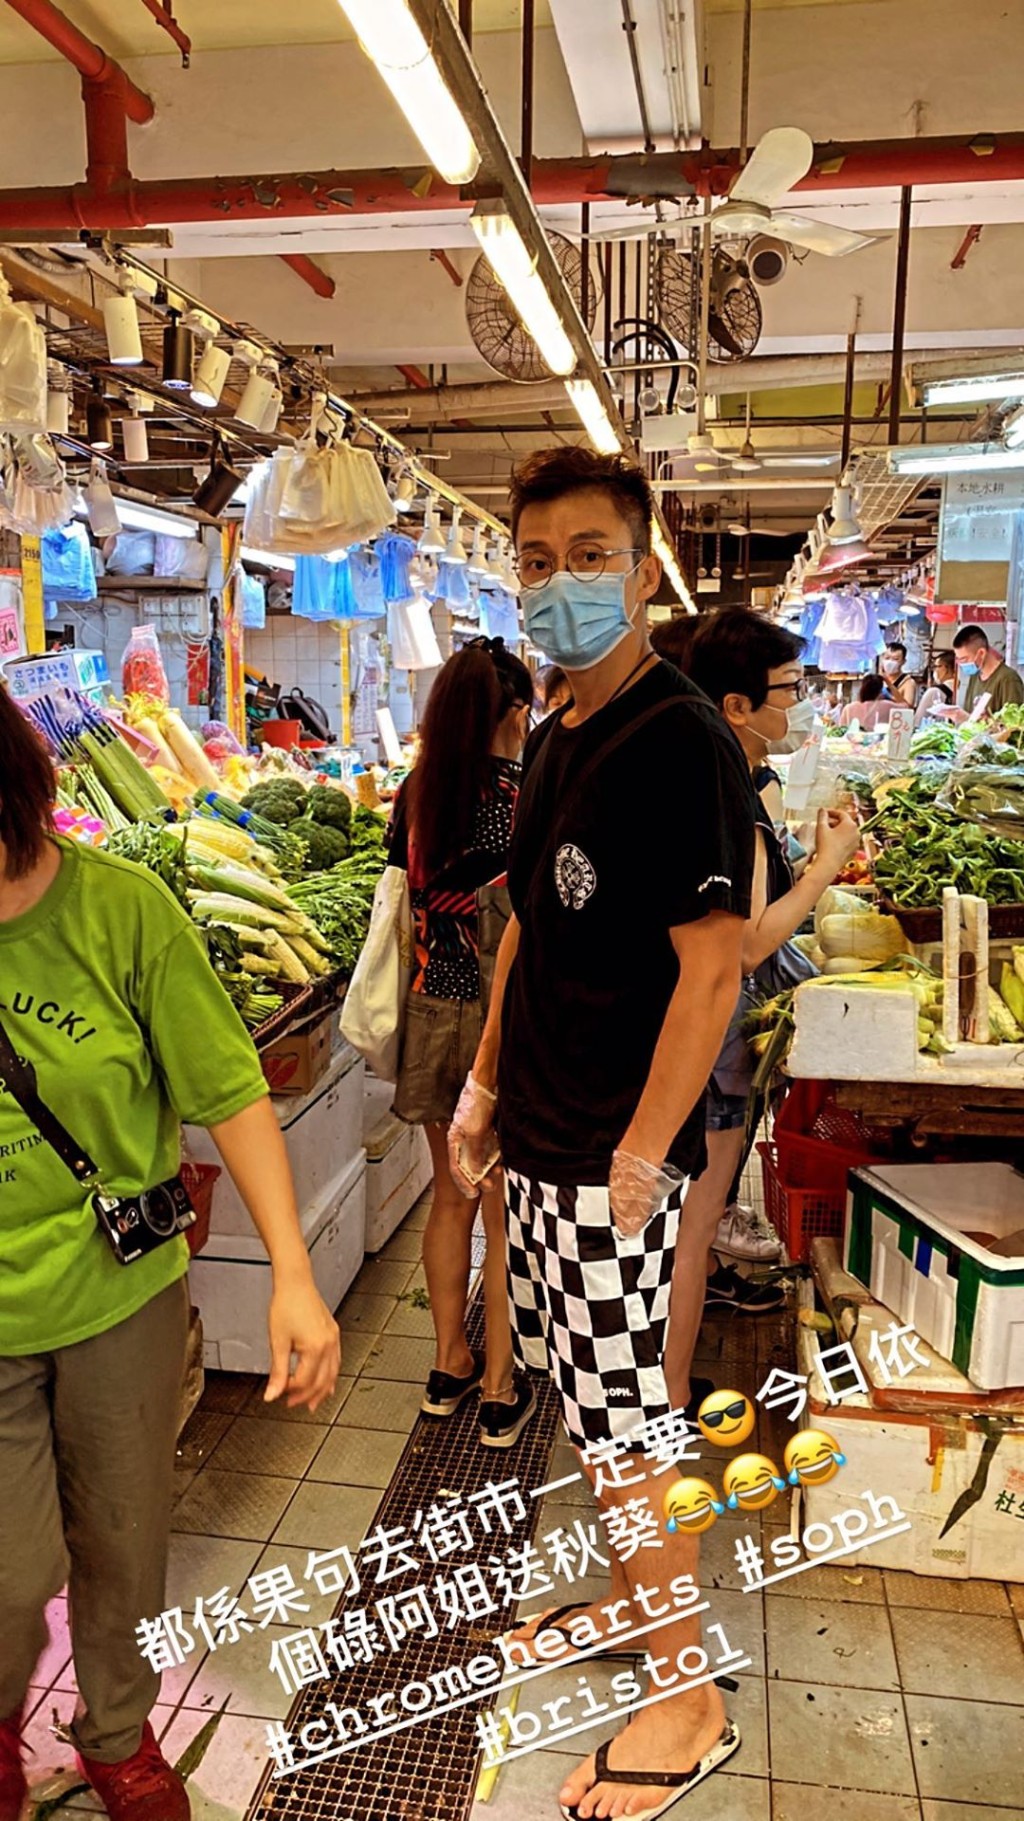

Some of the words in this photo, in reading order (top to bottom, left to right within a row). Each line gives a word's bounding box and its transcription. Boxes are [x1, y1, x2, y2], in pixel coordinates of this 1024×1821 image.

[14, 662, 69, 678] さつまいも
[0, 991, 97, 1044] UCK!
[0, 1169, 16, 1183] K
